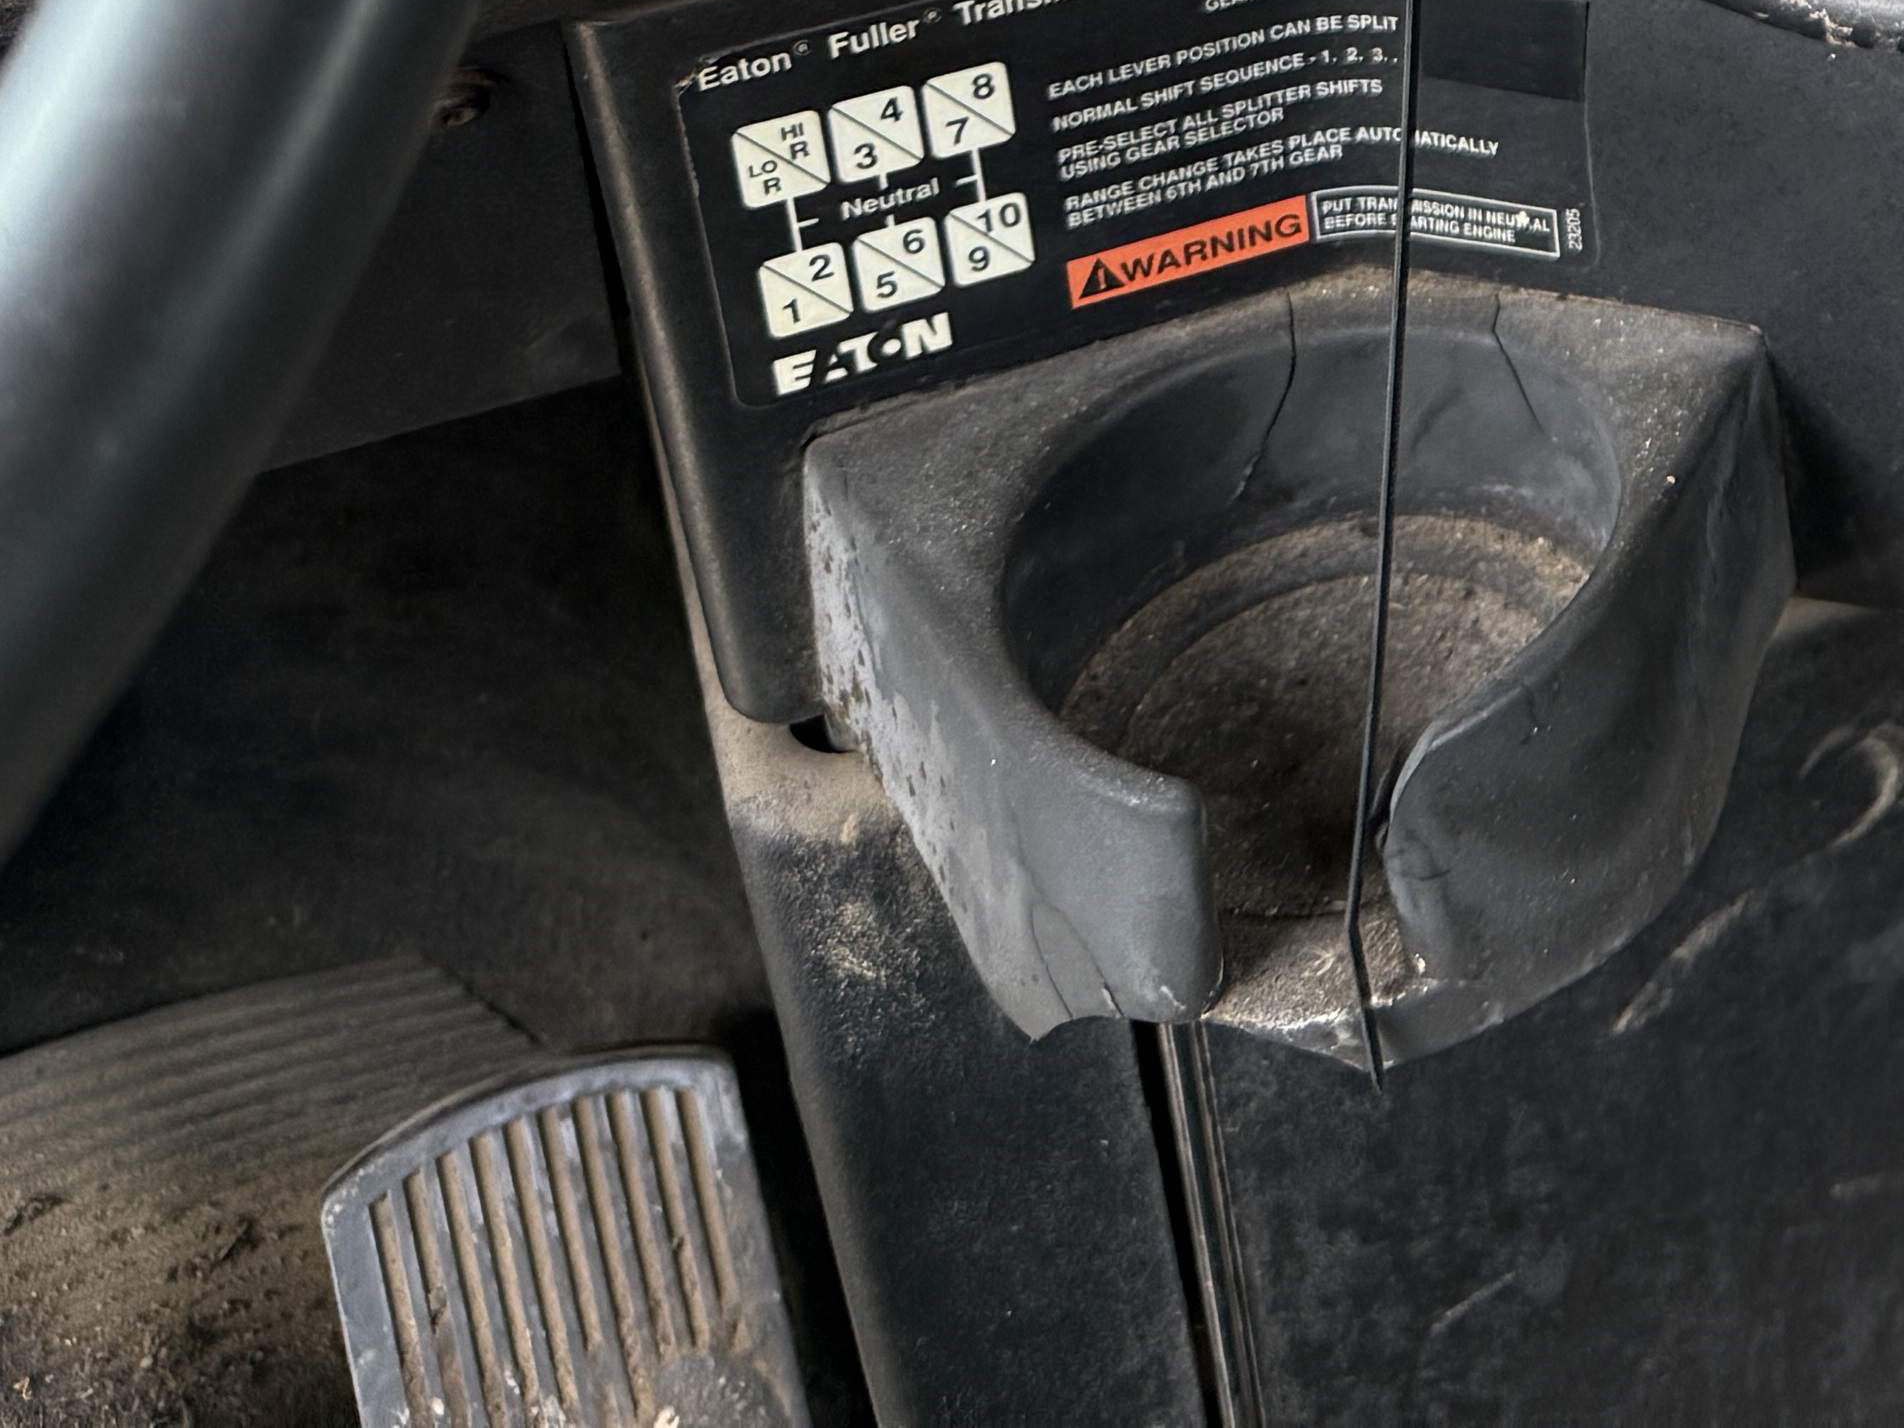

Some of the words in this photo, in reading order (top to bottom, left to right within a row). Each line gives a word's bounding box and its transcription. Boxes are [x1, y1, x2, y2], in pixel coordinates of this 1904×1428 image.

[697, 48, 794, 92] Eaton
[827, 15, 921, 61] Fuller
[1048, 71, 1104, 100] EACH
[1107, 53, 1172, 85] LEVER
[1175, 29, 1265, 66] POSITION
[1268, 18, 1312, 40] CAN
[1347, 14, 1400, 33] SPLIT
[970, 73, 996, 101] 8
[1051, 97, 1139, 133] NORMAL
[1139, 79, 1195, 110] SHIFT
[1199, 51, 1305, 92] SEQUENCE
[878, 97, 905, 123] 4
[1056, 118, 1179, 166] PRE-SELECT
[1182, 109, 1220, 132] ALL
[1221, 84, 1312, 120] SPLITTER
[1315, 78, 1384, 99] SHIFTS
[779, 122, 806, 144] HI
[944, 116, 971, 145] 7
[1060, 152, 1122, 182] USING
[1125, 135, 1181, 163] GEAR
[1184, 107, 1285, 146] SELECTOR
[747, 159, 779, 179] LO
[851, 142, 880, 170] 3
[1064, 180, 1136, 214] RANGE
[1137, 156, 1220, 193] CHANGE
[1224, 138, 1285, 167] TAKES
[1288, 127, 1351, 151] PLACE
[839, 176, 941, 221] Neutral
[1066, 189, 1163, 230] BETWEEN
[1204, 167, 1247, 191] AND
[1288, 144, 1344, 166] GEAR
[975, 201, 1022, 236] 10
[901, 228, 927, 255] 6
[966, 243, 992, 272] 9
[1119, 212, 1303, 284] WARNING
[807, 254, 835, 283] 2
[874, 271, 898, 300] 5
[771, 310, 953, 397] EATON
